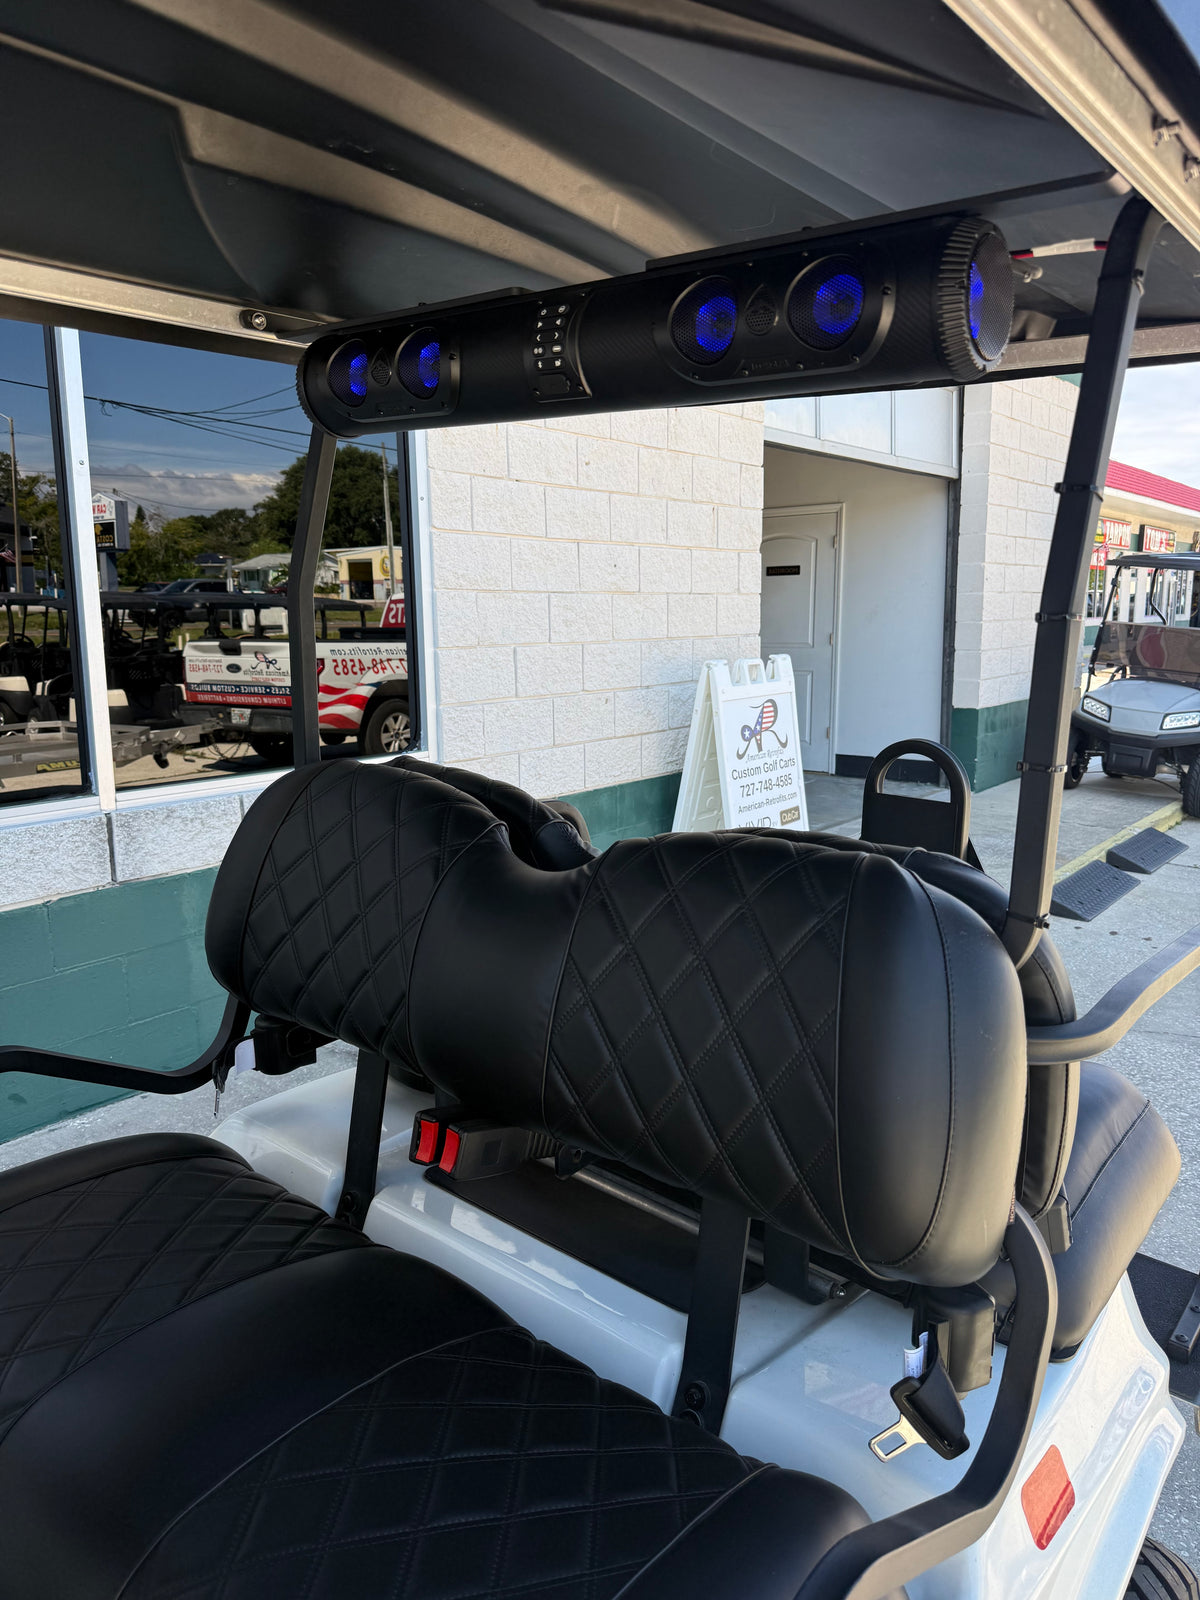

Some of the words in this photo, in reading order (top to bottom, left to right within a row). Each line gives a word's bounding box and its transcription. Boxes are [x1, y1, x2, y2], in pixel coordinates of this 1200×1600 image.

[1106, 521, 1131, 547] TARPON
[1146, 528, 1167, 552] TOM'S
[731, 765, 761, 780] Custom
[763, 760, 777, 773] Golf
[779, 757, 796, 769] Carts
[740, 773, 793, 798] 727-748-4585
[738, 791, 797, 814] American-Retrofits.com
